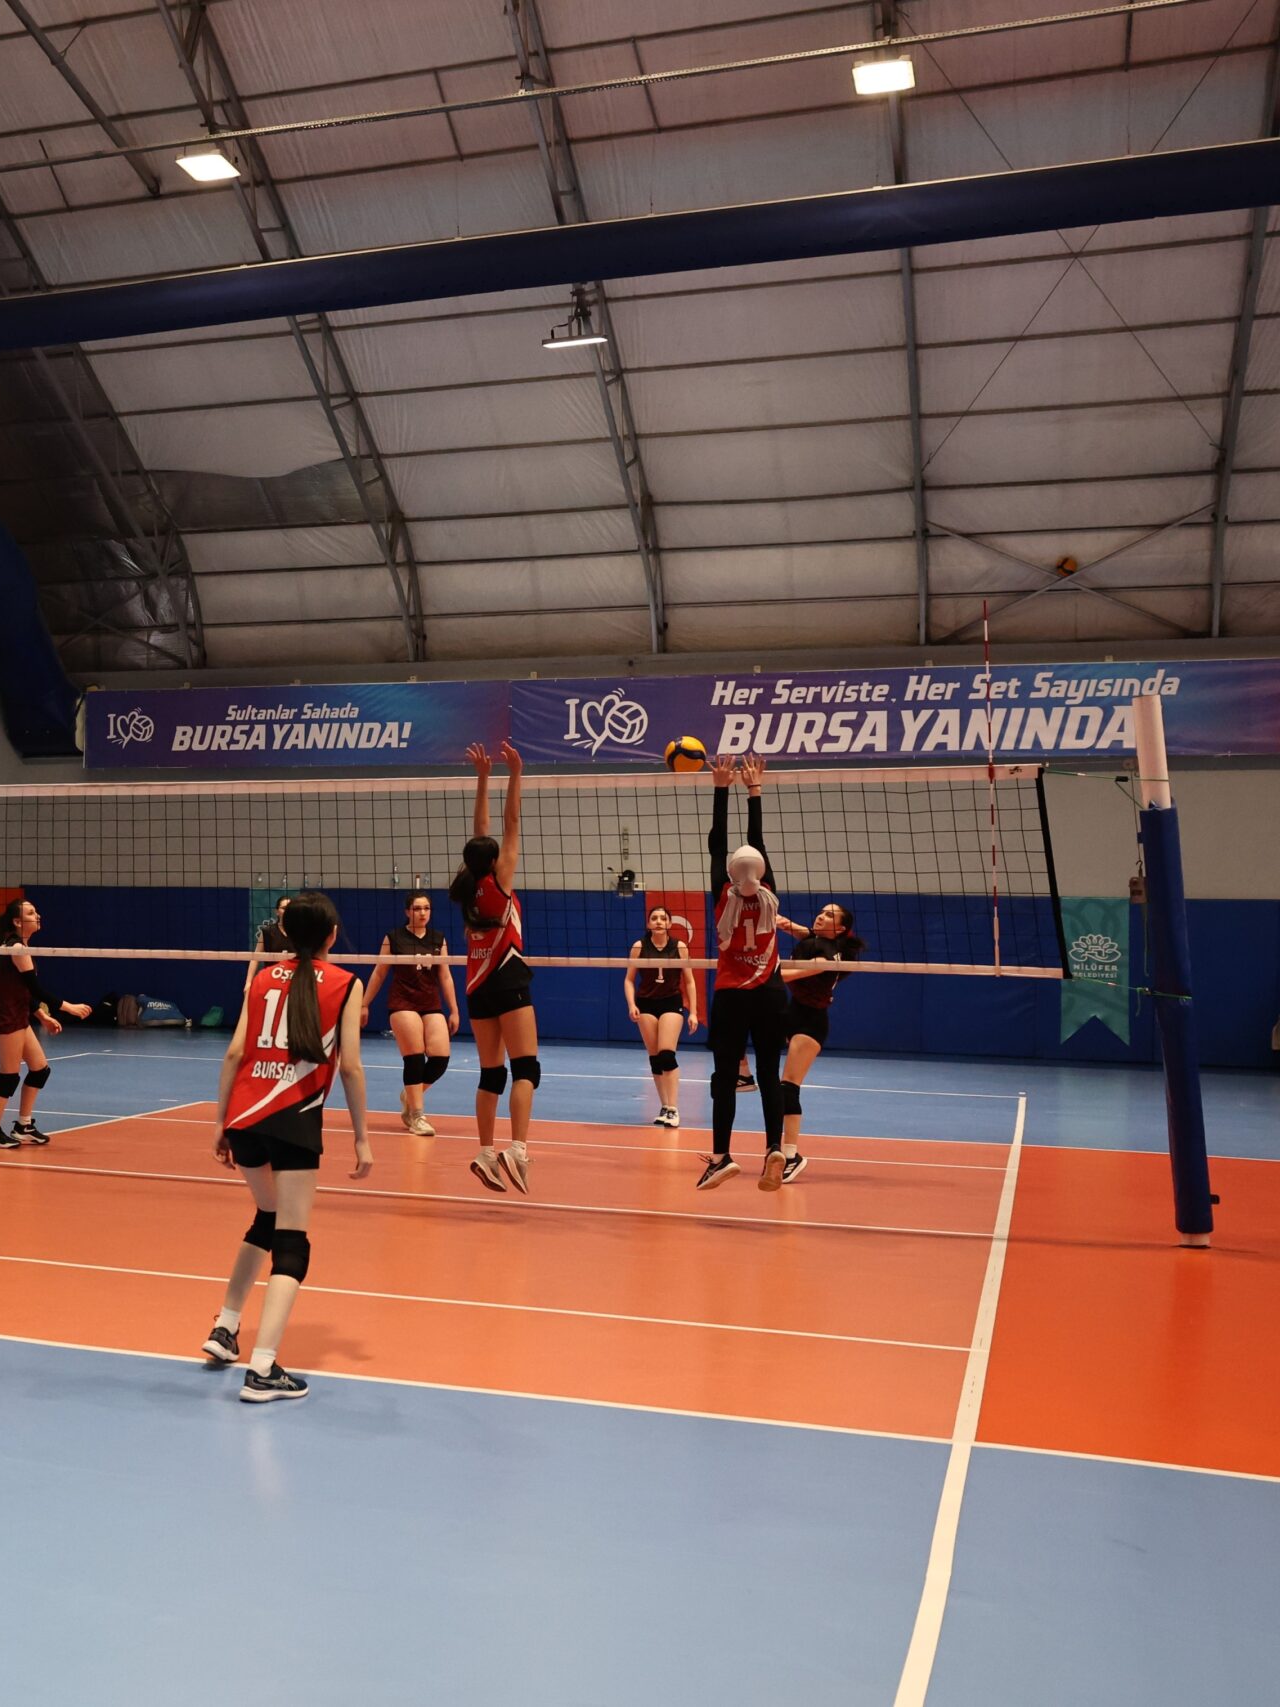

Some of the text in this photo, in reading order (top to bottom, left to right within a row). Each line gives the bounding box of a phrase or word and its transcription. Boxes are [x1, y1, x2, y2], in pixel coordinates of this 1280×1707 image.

[710, 679, 764, 706] Her
[905, 675, 961, 702] Her
[968, 673, 1022, 700] Set
[1029, 669, 1181, 705] Sayısında
[224, 703, 360, 721] Sultanlar Sahada
[171, 721, 413, 751] BURSA YANINDA!
[716, 709, 888, 755] BURSA
[743, 918, 758, 952] 1
[1073, 963, 1118, 972] NİLÜFER
[251, 1060, 297, 1083] BURSA
